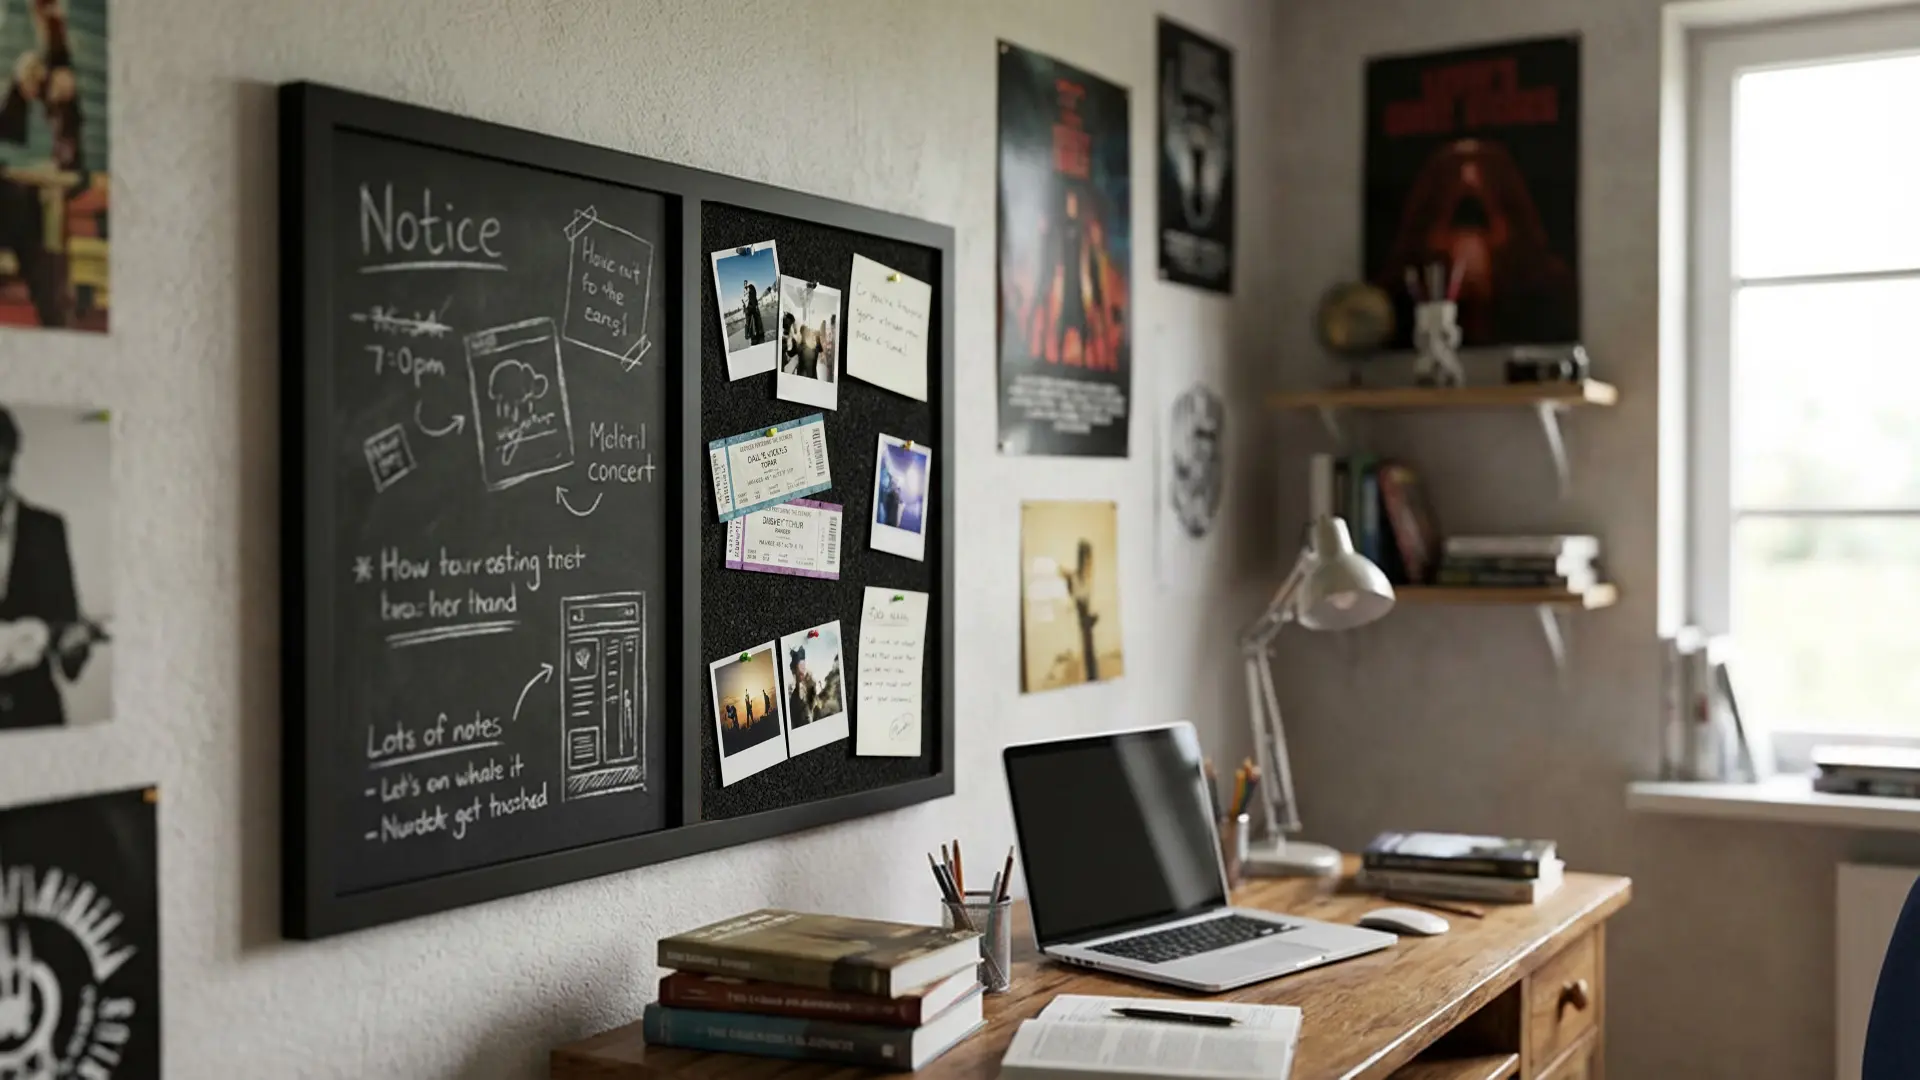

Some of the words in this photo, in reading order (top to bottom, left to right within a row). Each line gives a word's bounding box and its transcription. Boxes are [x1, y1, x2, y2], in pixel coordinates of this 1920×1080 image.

[359, 181, 502, 258] Notice
[380, 546, 430, 581] How
[366, 719, 417, 759] Lots
[423, 711, 448, 747] of
[452, 710, 503, 742] notes
[509, 753, 524, 778] it
[452, 795, 482, 840] get
